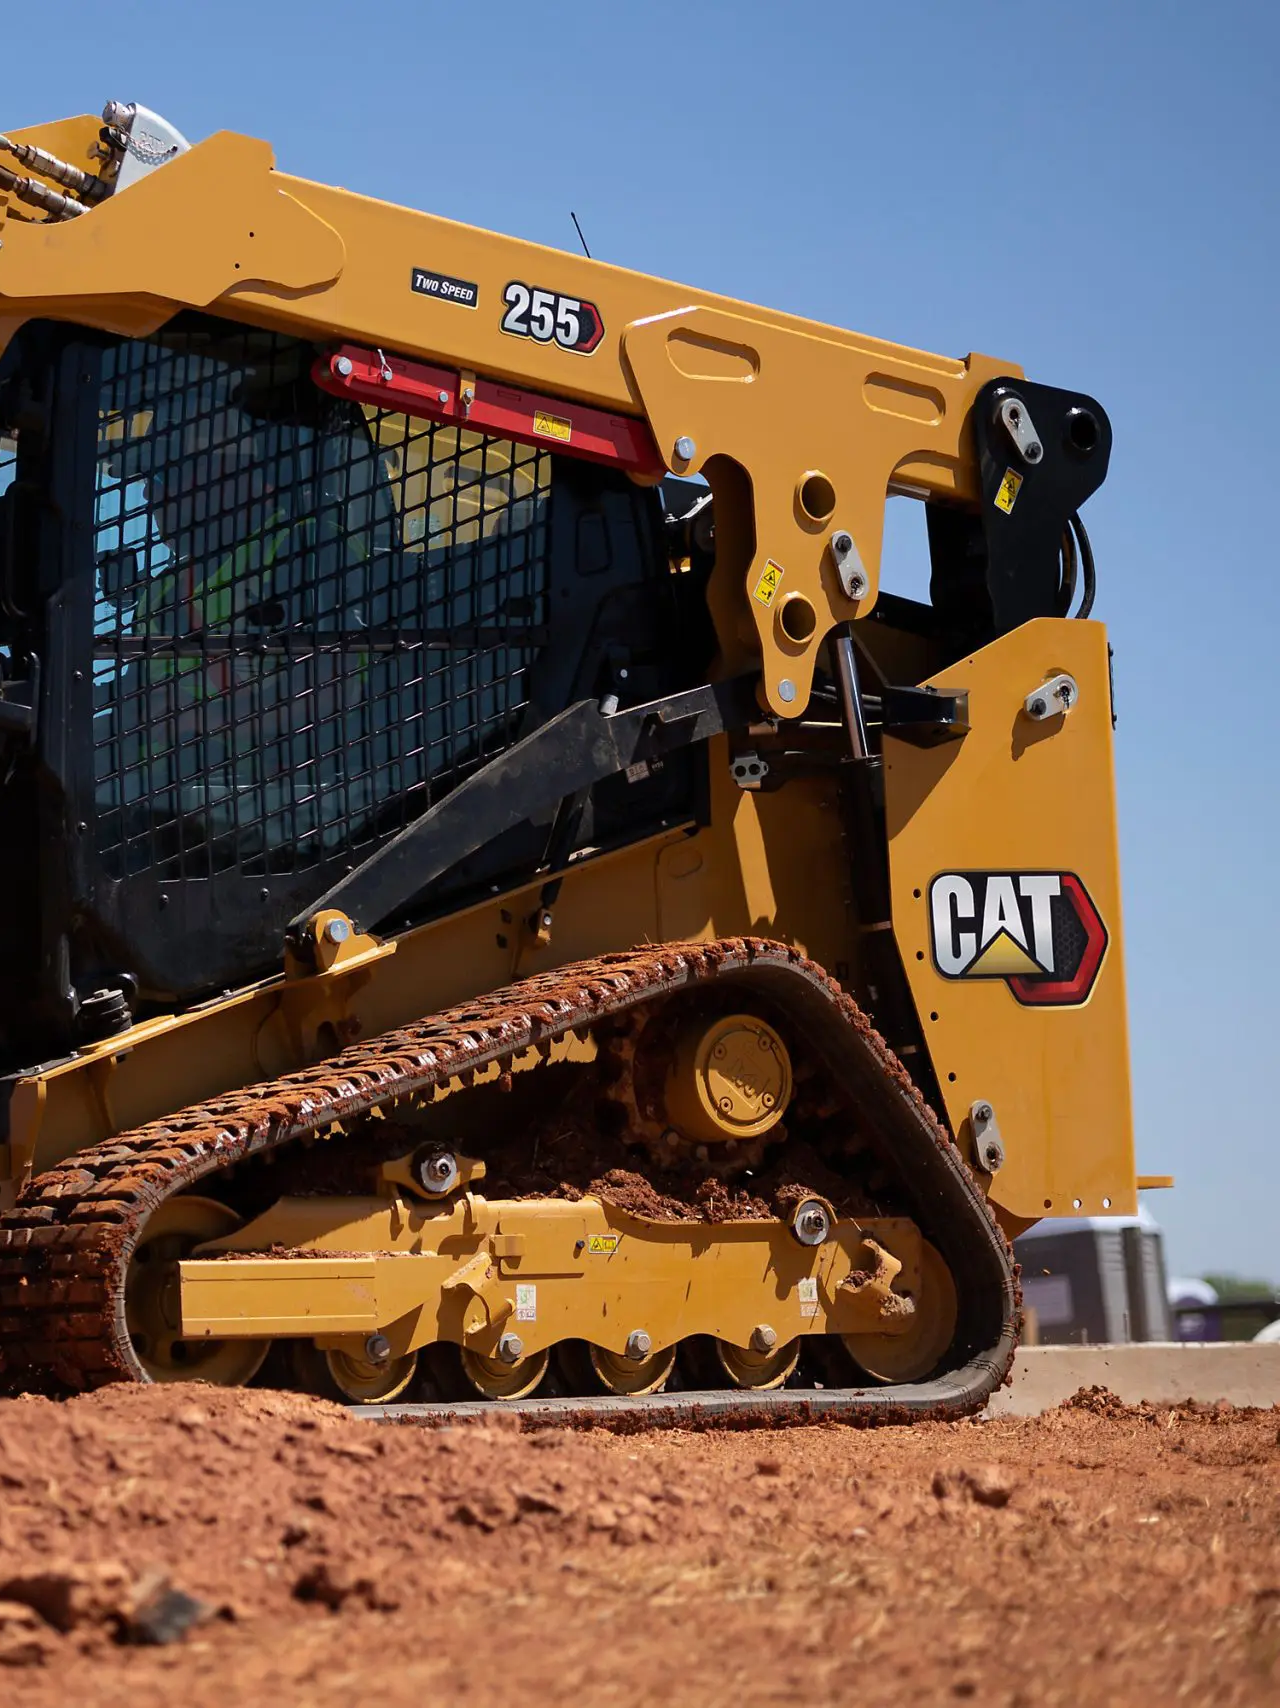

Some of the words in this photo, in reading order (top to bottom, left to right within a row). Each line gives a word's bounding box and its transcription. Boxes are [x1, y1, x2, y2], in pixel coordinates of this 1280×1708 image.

[415, 274, 439, 291] TWO
[440, 281, 474, 301] SPEED
[503, 284, 580, 346] 255
[931, 874, 1061, 975] CAT
